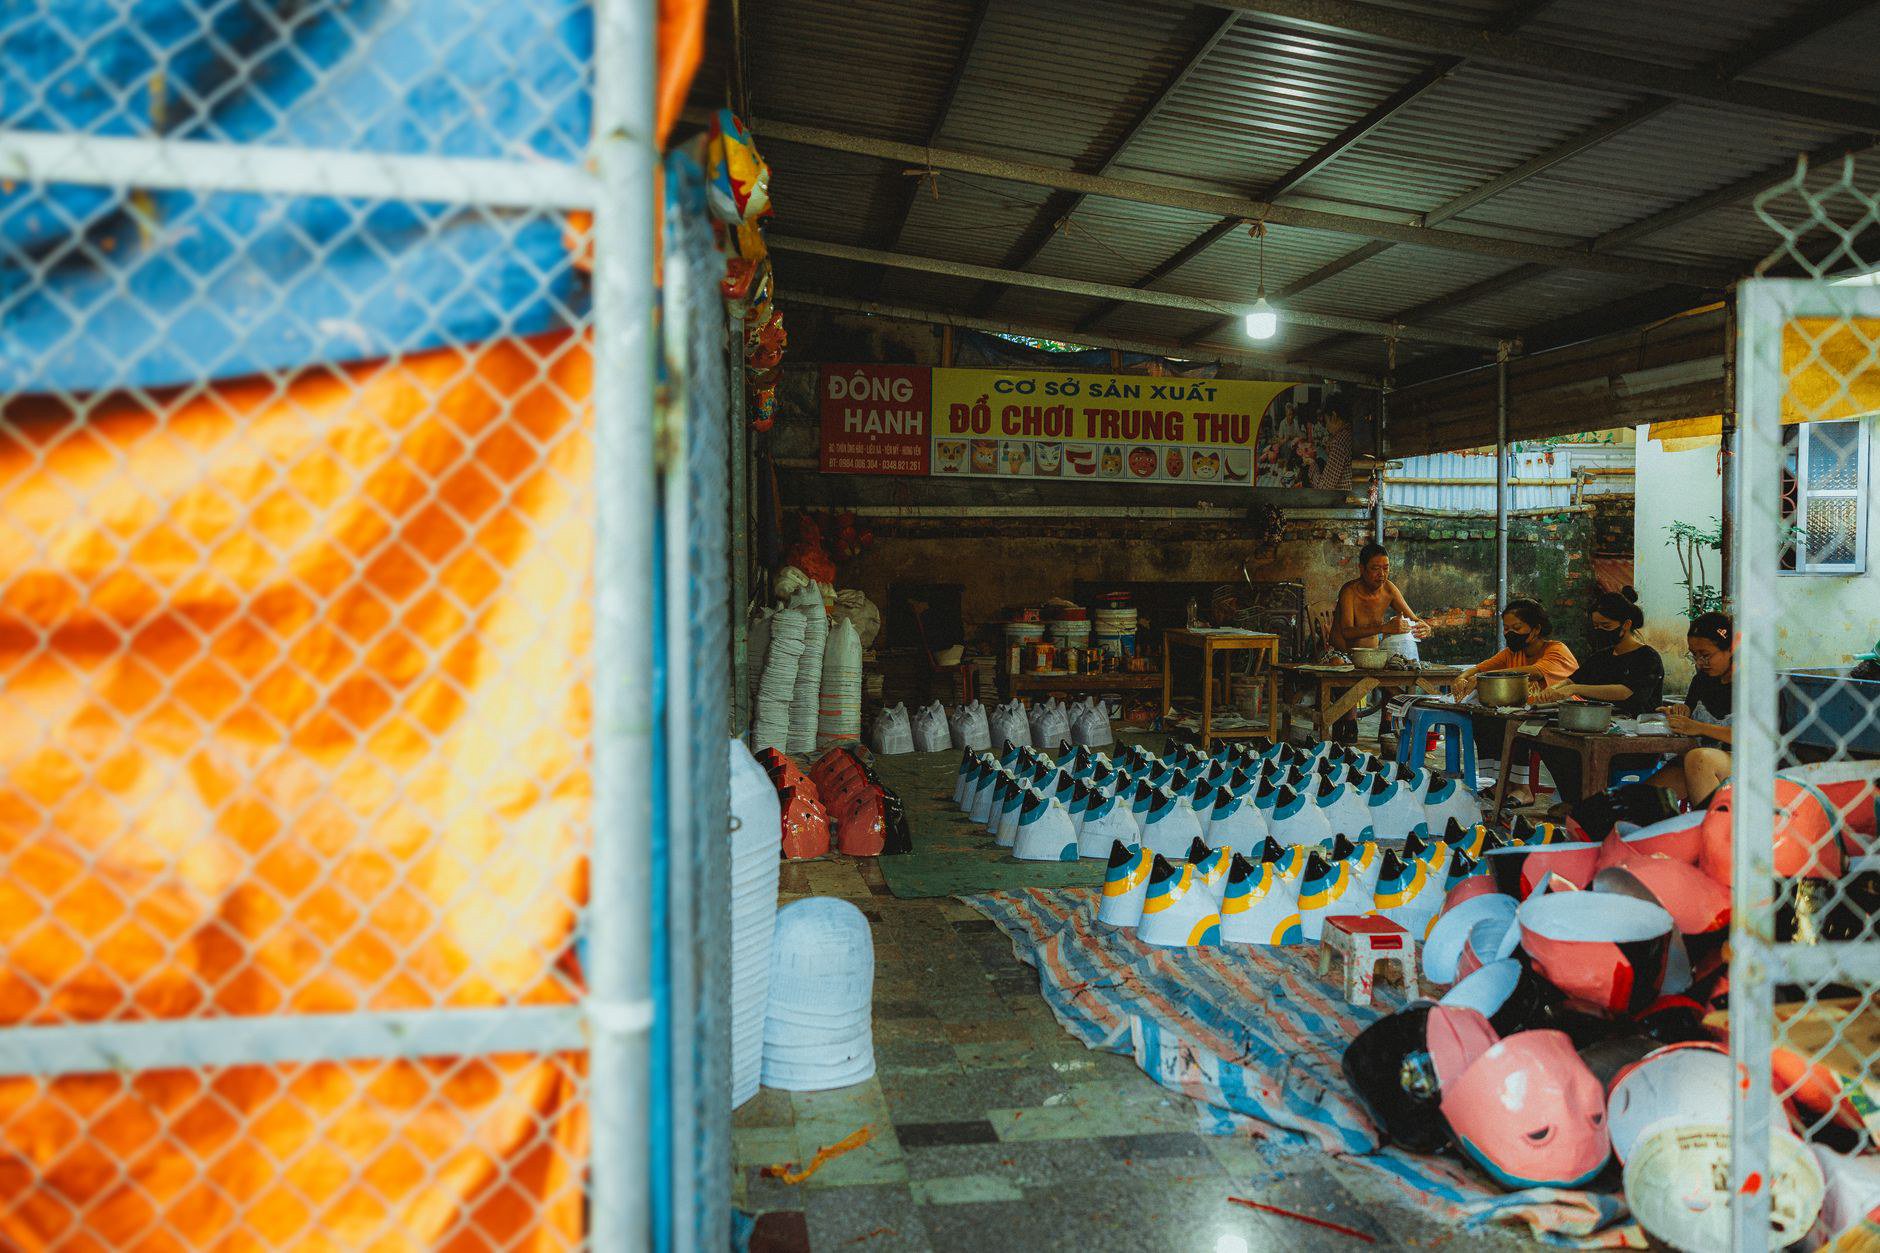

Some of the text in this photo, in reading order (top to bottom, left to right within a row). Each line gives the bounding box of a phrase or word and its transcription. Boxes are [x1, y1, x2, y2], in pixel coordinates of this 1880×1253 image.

[828, 369, 913, 402] ĐÔNG
[994, 377, 1217, 402] CƠ SỞ SẢN XUẤT
[845, 408, 923, 440] HẠNH
[1002, 404, 1073, 437] CHƠI
[1083, 408, 1184, 441] TRUNG
[1193, 412, 1250, 444] THU
